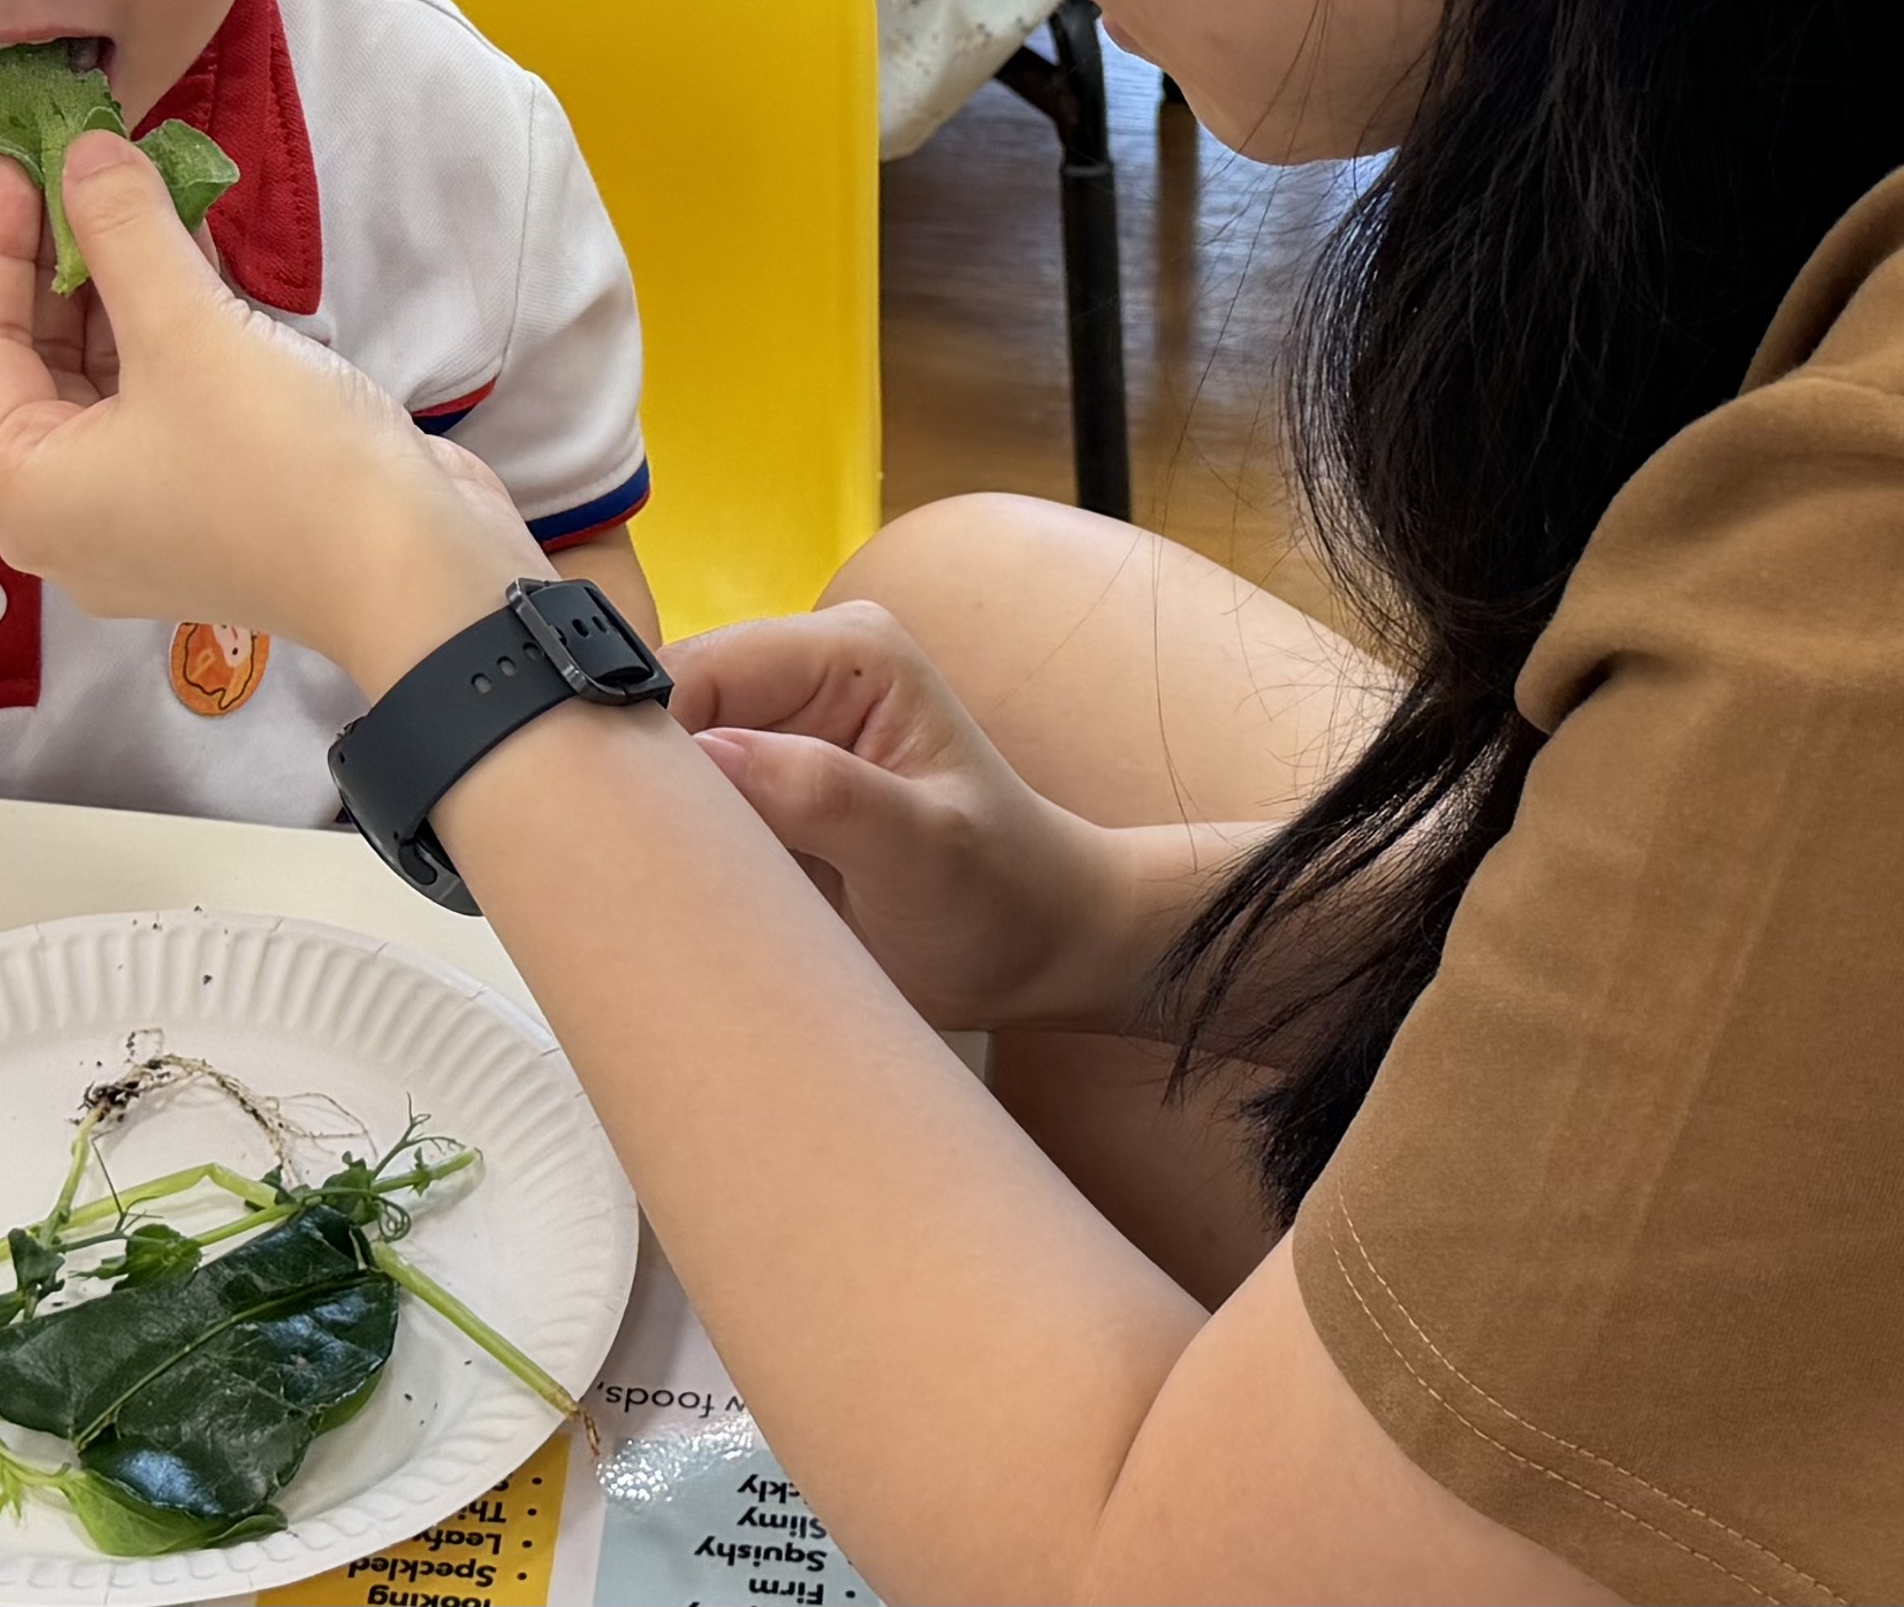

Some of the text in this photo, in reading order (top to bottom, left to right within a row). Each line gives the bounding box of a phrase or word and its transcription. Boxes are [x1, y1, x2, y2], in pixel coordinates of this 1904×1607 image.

[596, 1381, 715, 1419] foods,
[736, 1474, 802, 1504] ckly
[736, 1506, 827, 1540] Slimy
[694, 1536, 828, 1573] Squishy
[347, 1557, 497, 1588] Speckled
[749, 1578, 824, 1606] Firm
